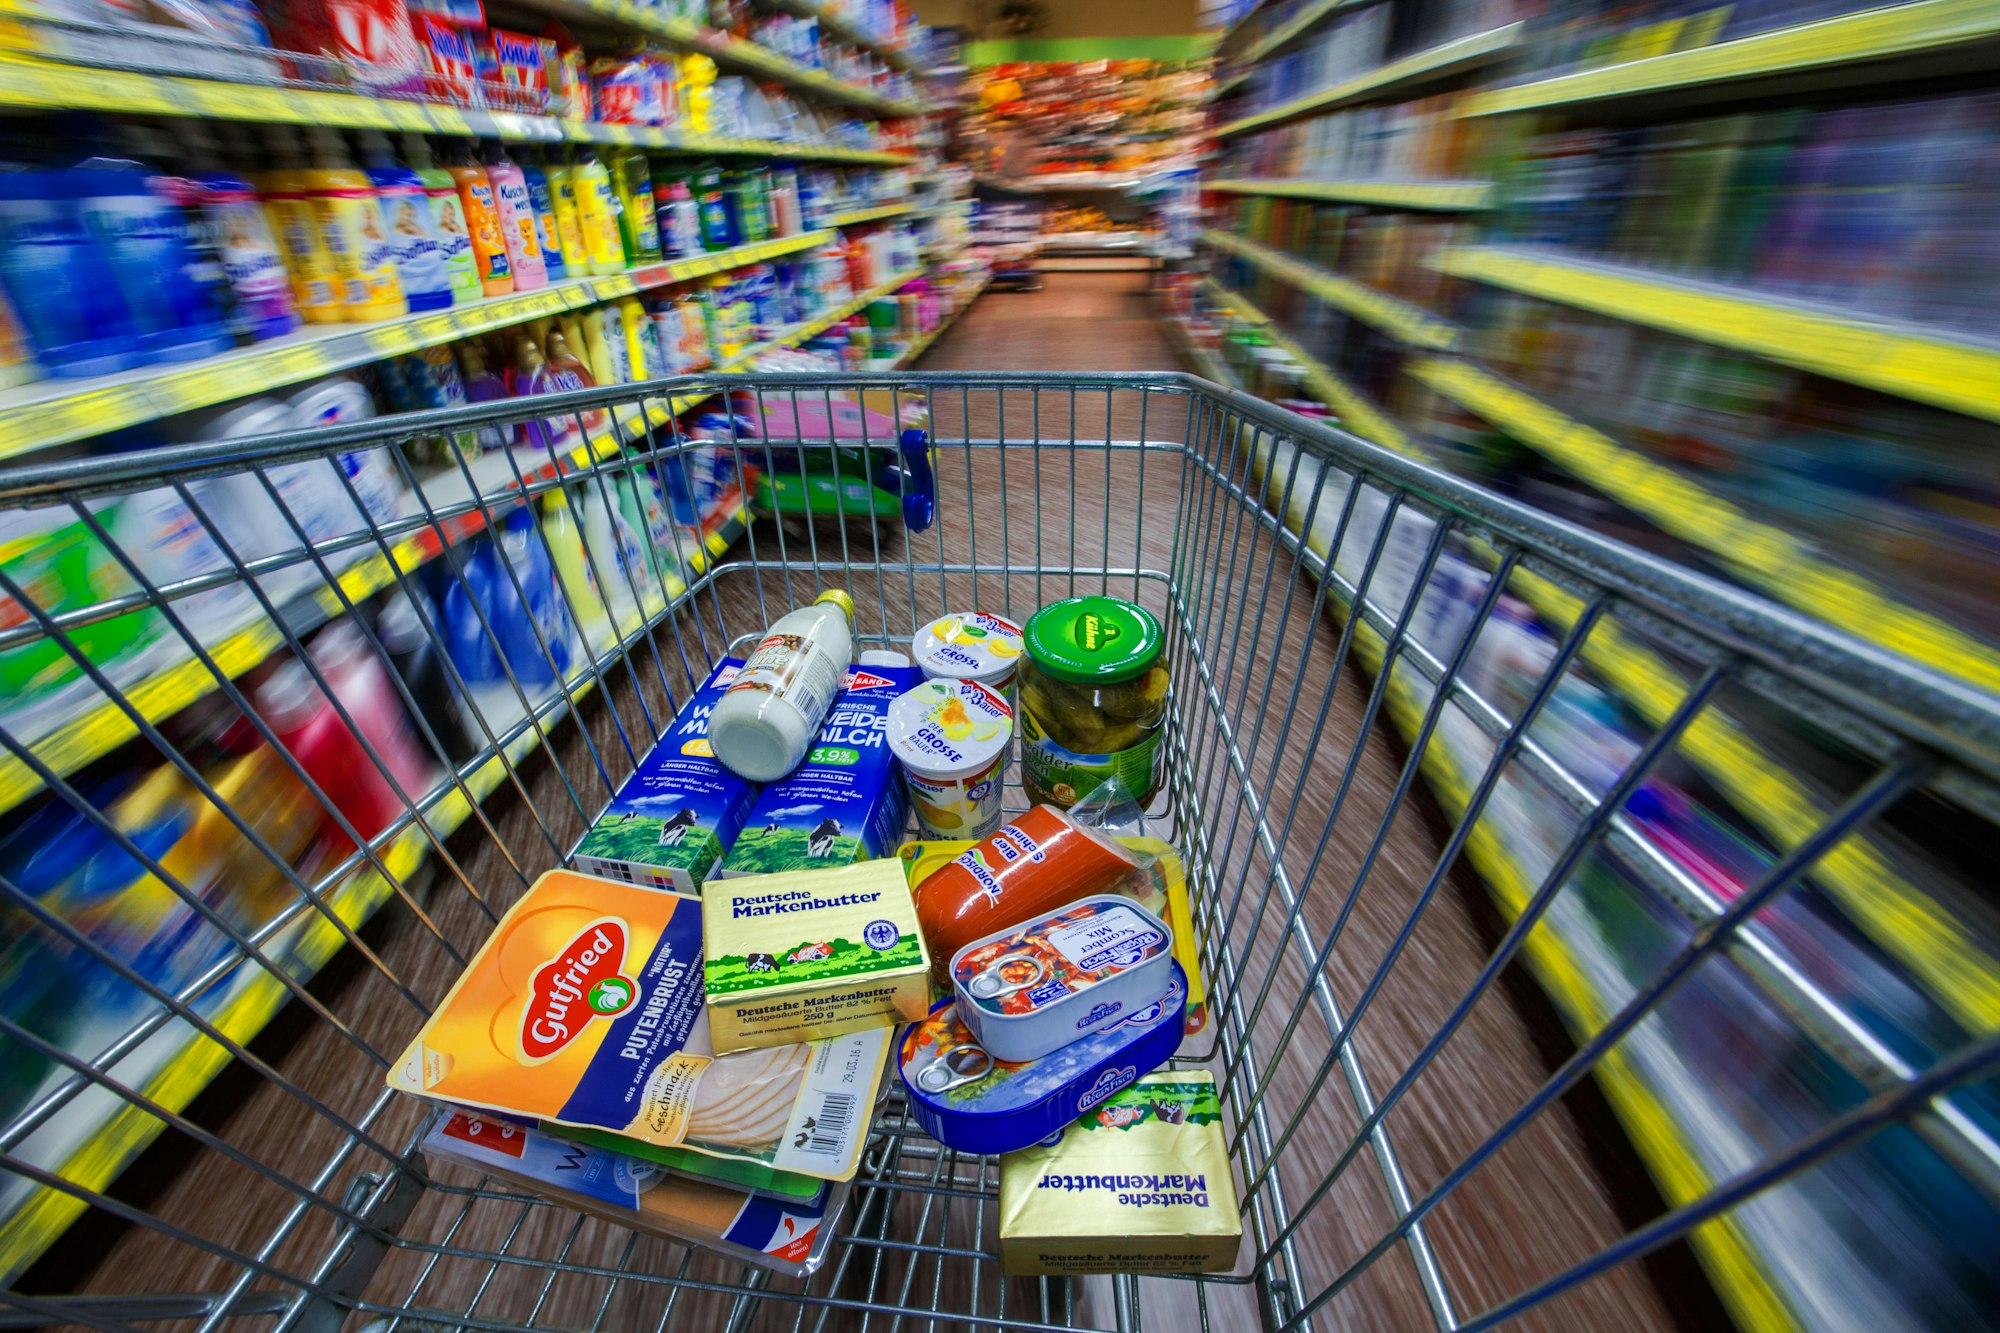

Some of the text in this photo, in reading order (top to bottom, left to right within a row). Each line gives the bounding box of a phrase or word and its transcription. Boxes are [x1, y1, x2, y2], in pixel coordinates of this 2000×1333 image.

[1085, 614, 1100, 650] Kühne
[928, 722, 944, 735] DER
[917, 728, 963, 763] GROSSE
[958, 855, 1001, 895] NORDISCH
[732, 890, 811, 907] Deutsche
[733, 892, 881, 919] Markenbutter
[1080, 926, 1136, 954] Scomber
[1089, 925, 1114, 940] Mix
[531, 929, 614, 1044] Gutfried
[620, 958, 688, 1060] PUTENBRUST
[736, 986, 898, 1018] Deutsche Markenbutter
[742, 1007, 812, 1024] Mildgesäuerte
[815, 1002, 844, 1013] Butter
[846, 1000, 859, 1009] 82
[873, 995, 892, 1004] Fett
[803, 1011, 835, 1022] 250 g
[624, 1086, 636, 1103] aus
[633, 1057, 651, 1085] zarten
[646, 986, 686, 1055] Putenbruststücken
[663, 1033, 673, 1048] mit
[842, 1049, 861, 1083] 29.03.16
[650, 1059, 690, 1133] Geschmack
[1037, 1174, 1207, 1193] Markenbutter
[1118, 1192, 1210, 1208] Deutsche
[1107, 1253, 1210, 1262] Markenbutter
